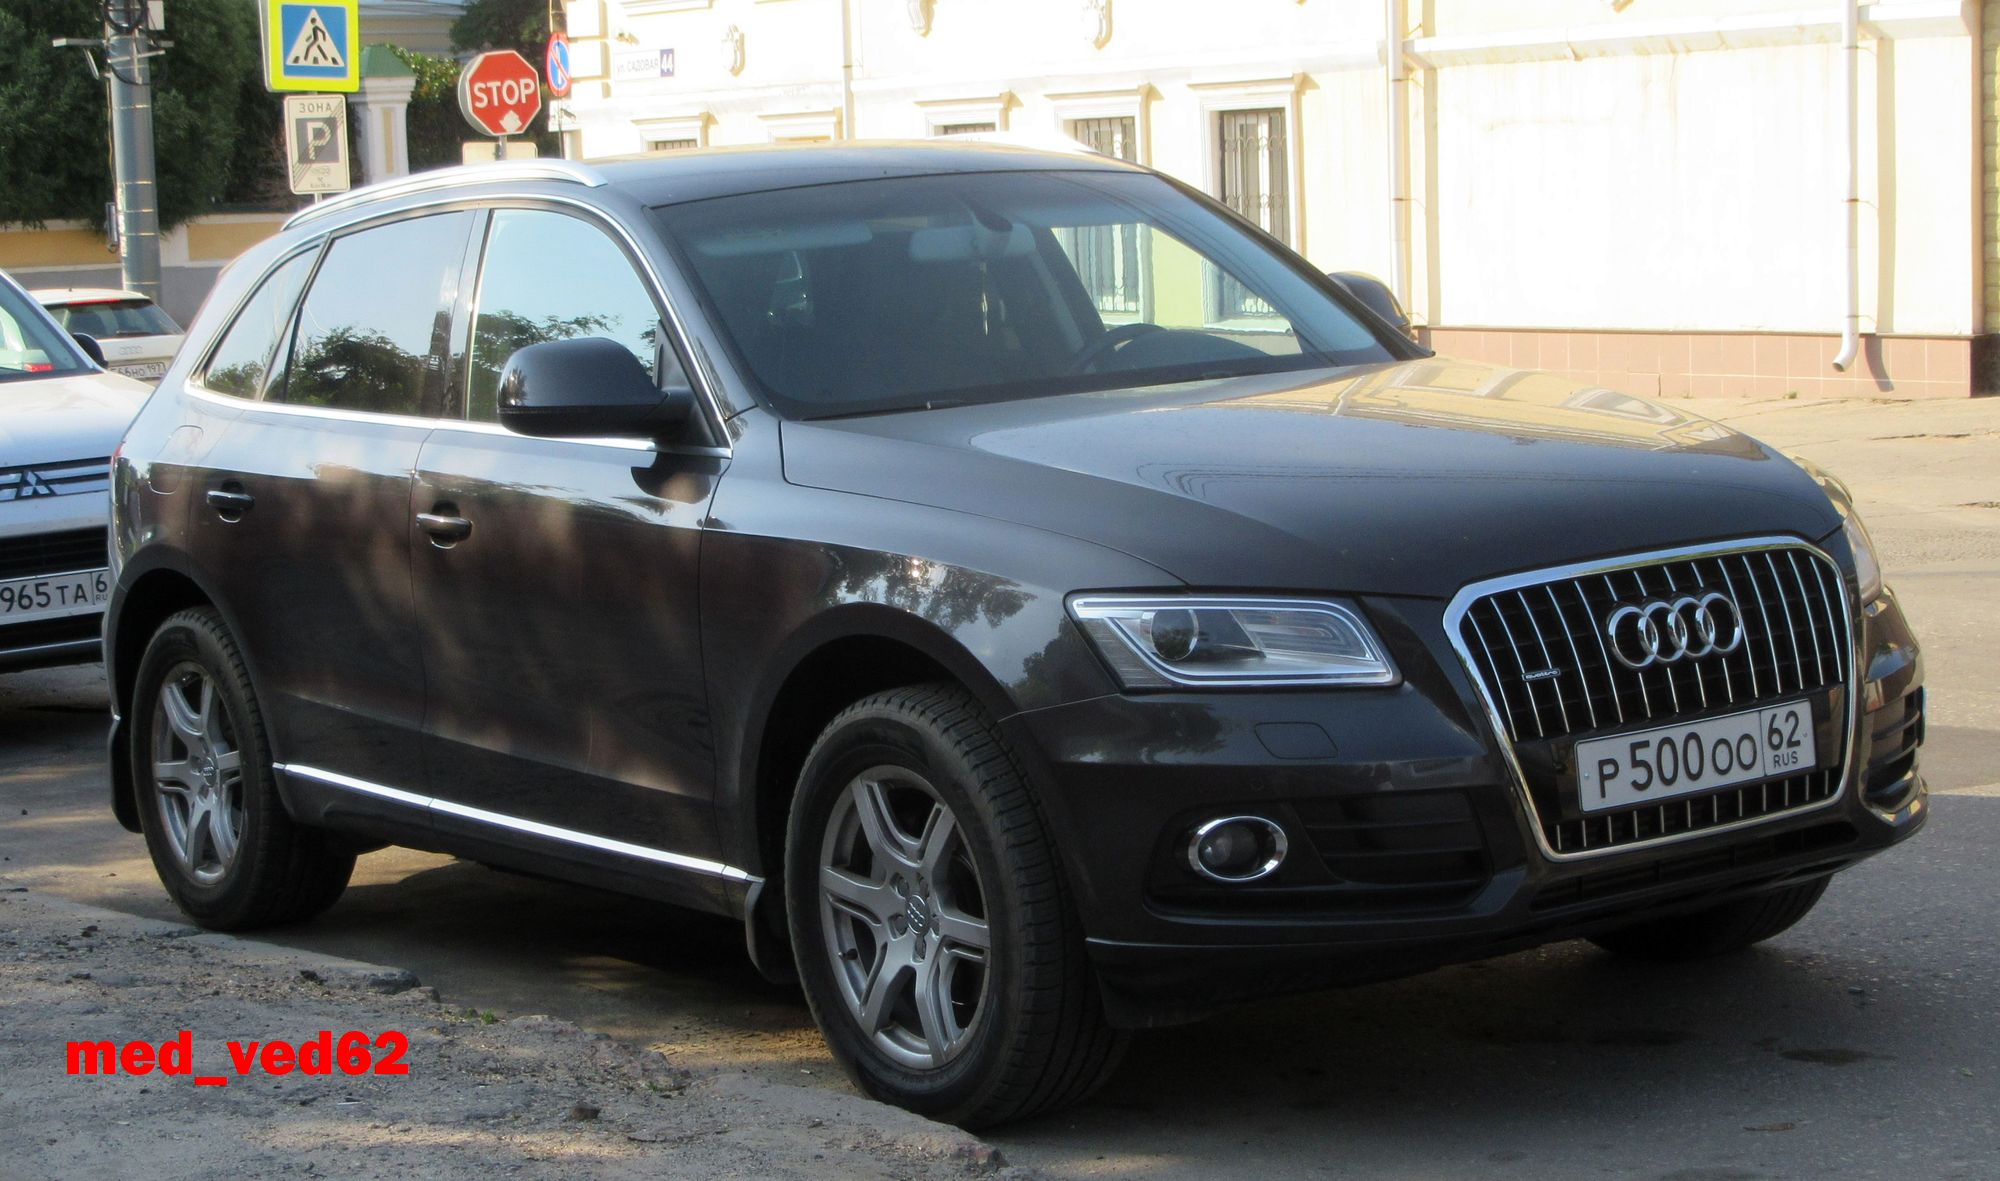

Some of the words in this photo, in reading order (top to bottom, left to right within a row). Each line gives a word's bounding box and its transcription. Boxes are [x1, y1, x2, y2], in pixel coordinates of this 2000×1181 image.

[661, 53, 673, 73] 44
[473, 78, 535, 109] STOP
[299, 102, 332, 113] ЗОНА
[1767, 710, 1801, 751] 62
[1773, 752, 1799, 769] RUS
